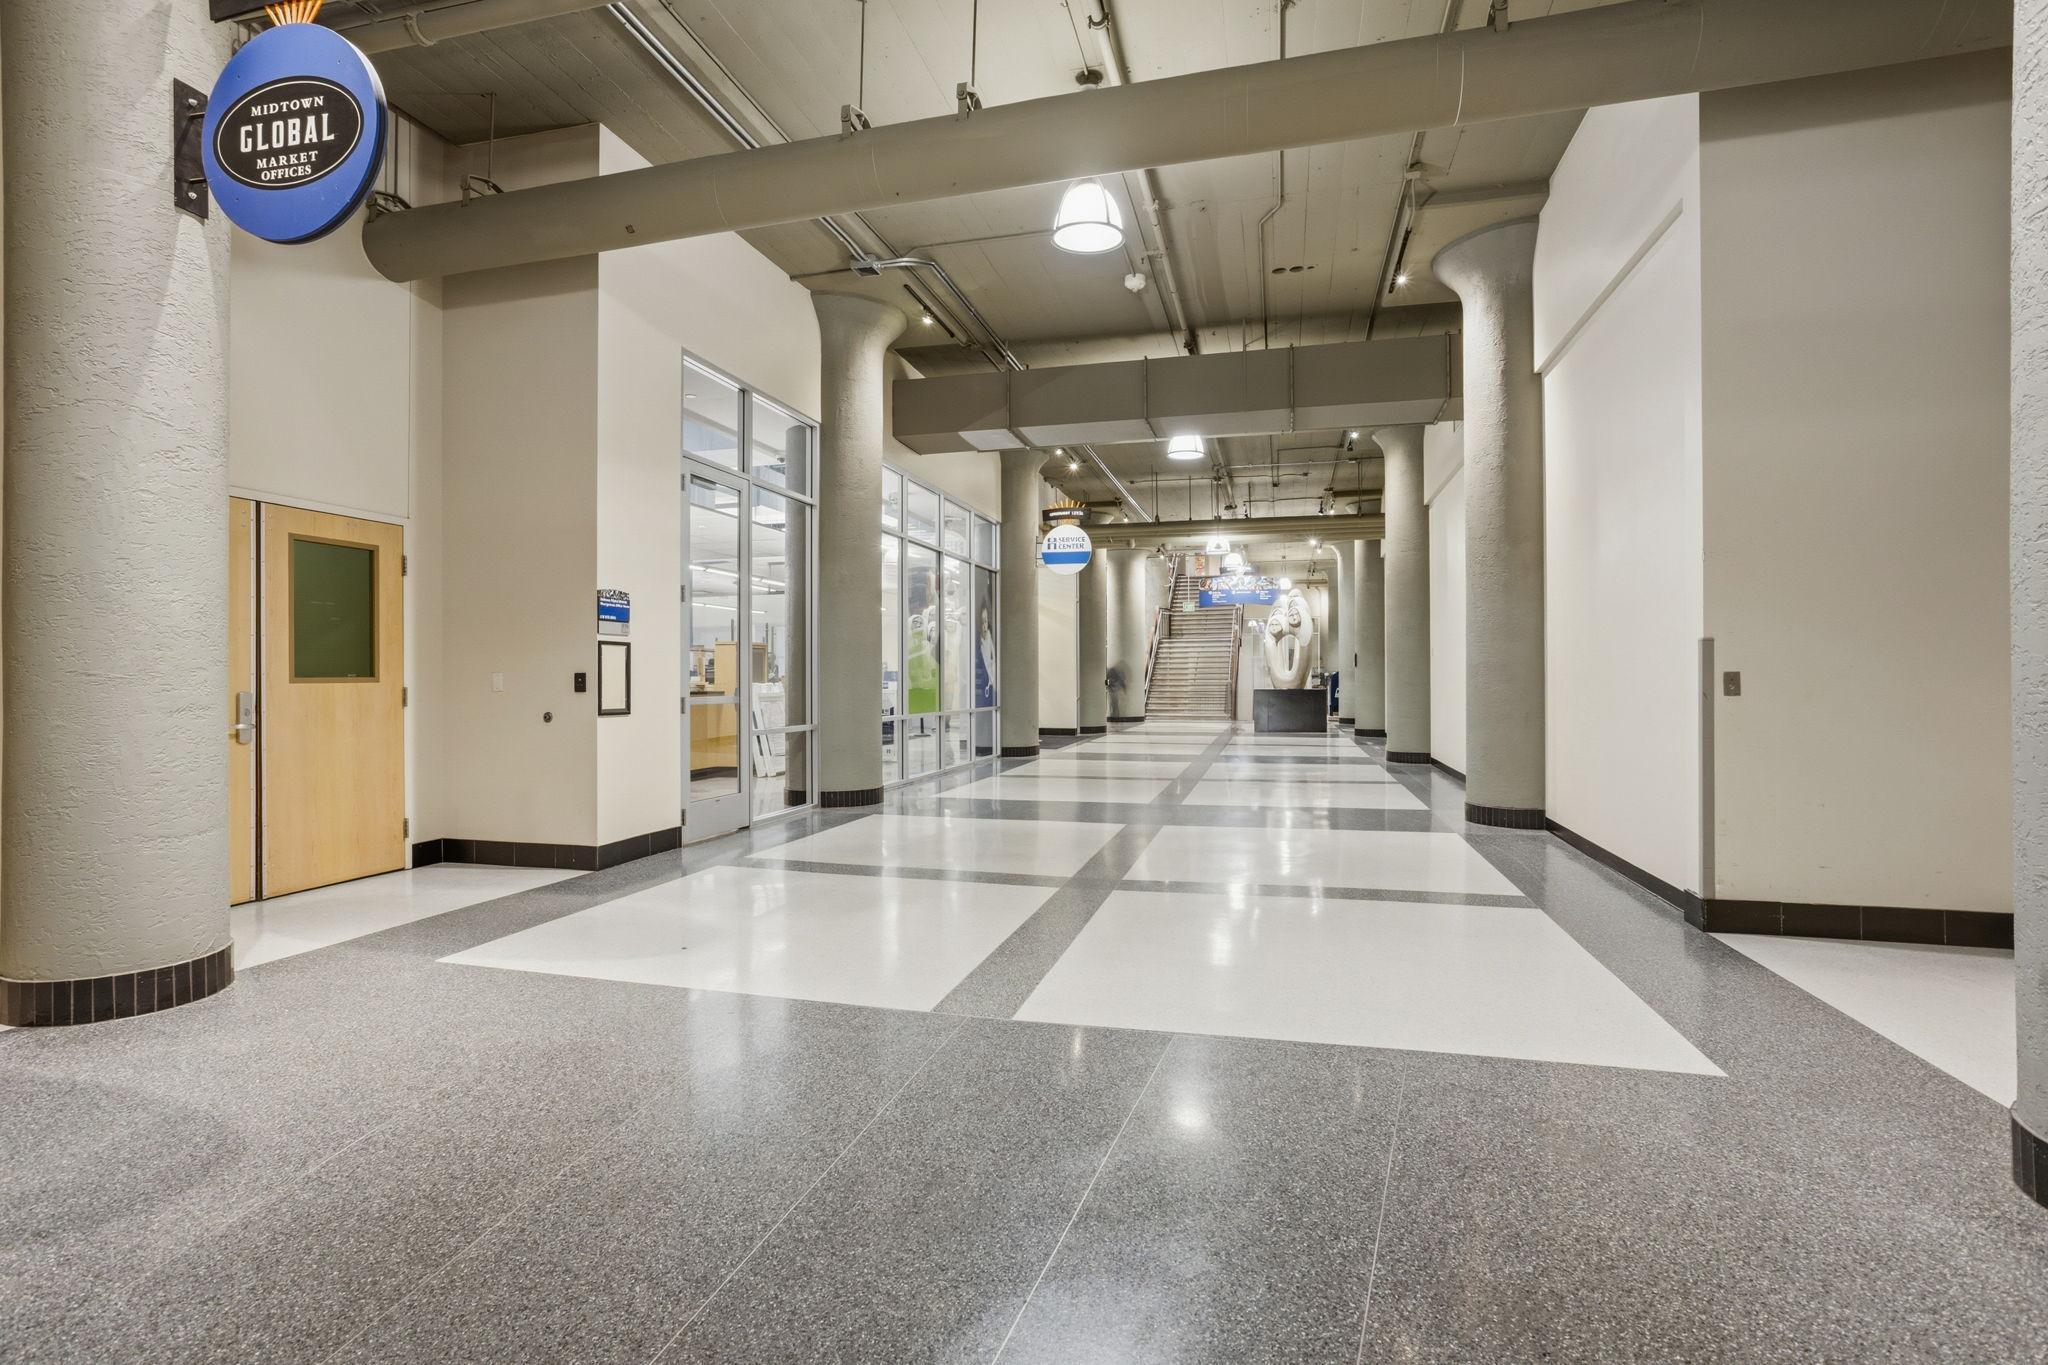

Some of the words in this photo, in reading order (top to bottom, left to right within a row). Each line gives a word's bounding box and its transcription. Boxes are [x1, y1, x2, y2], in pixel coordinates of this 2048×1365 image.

[251, 96, 324, 116] MIDTOWN
[240, 113, 334, 153] GLOBAL
[256, 151, 318, 169] MARKET
[261, 165, 311, 181] OFFICES
